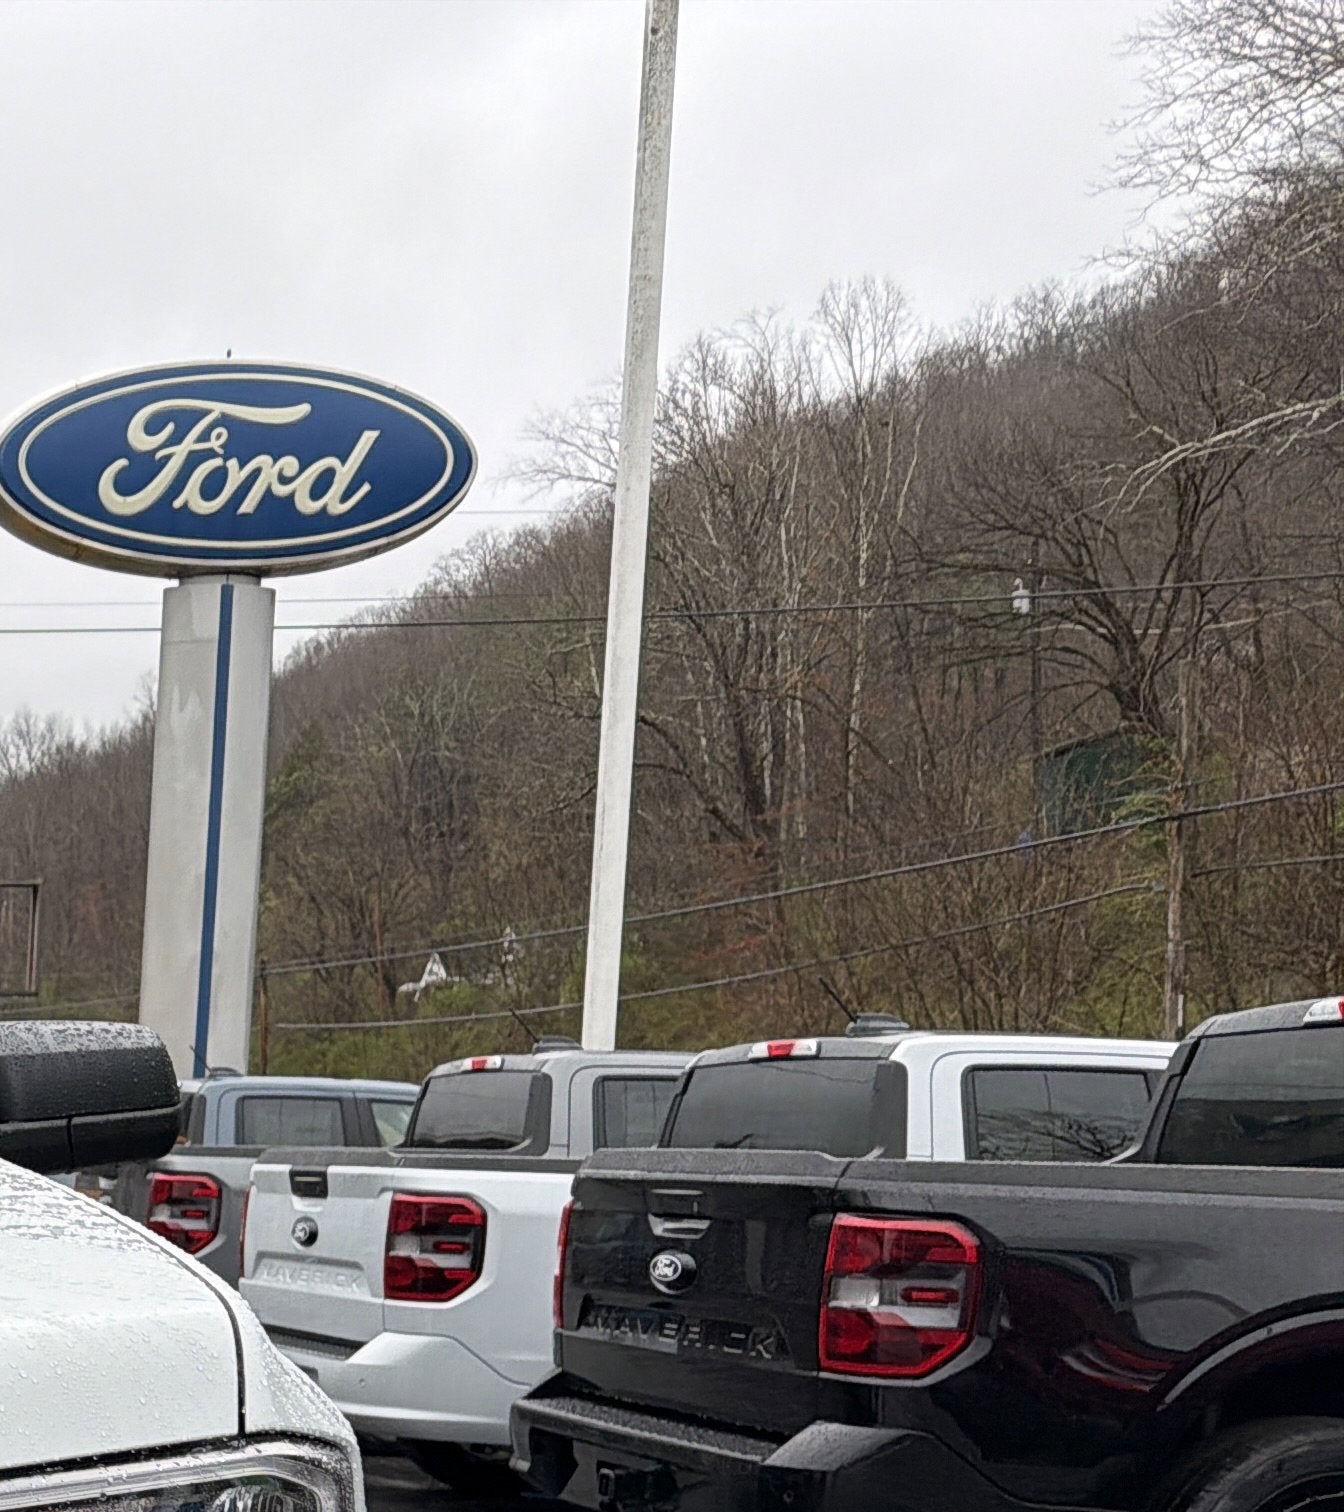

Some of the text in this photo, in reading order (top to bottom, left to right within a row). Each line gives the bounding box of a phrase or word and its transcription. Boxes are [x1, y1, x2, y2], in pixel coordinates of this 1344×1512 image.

[97, 397, 382, 516] Ford
[258, 1261, 363, 1295] AVERCK
[652, 1256, 678, 1279] Ford
